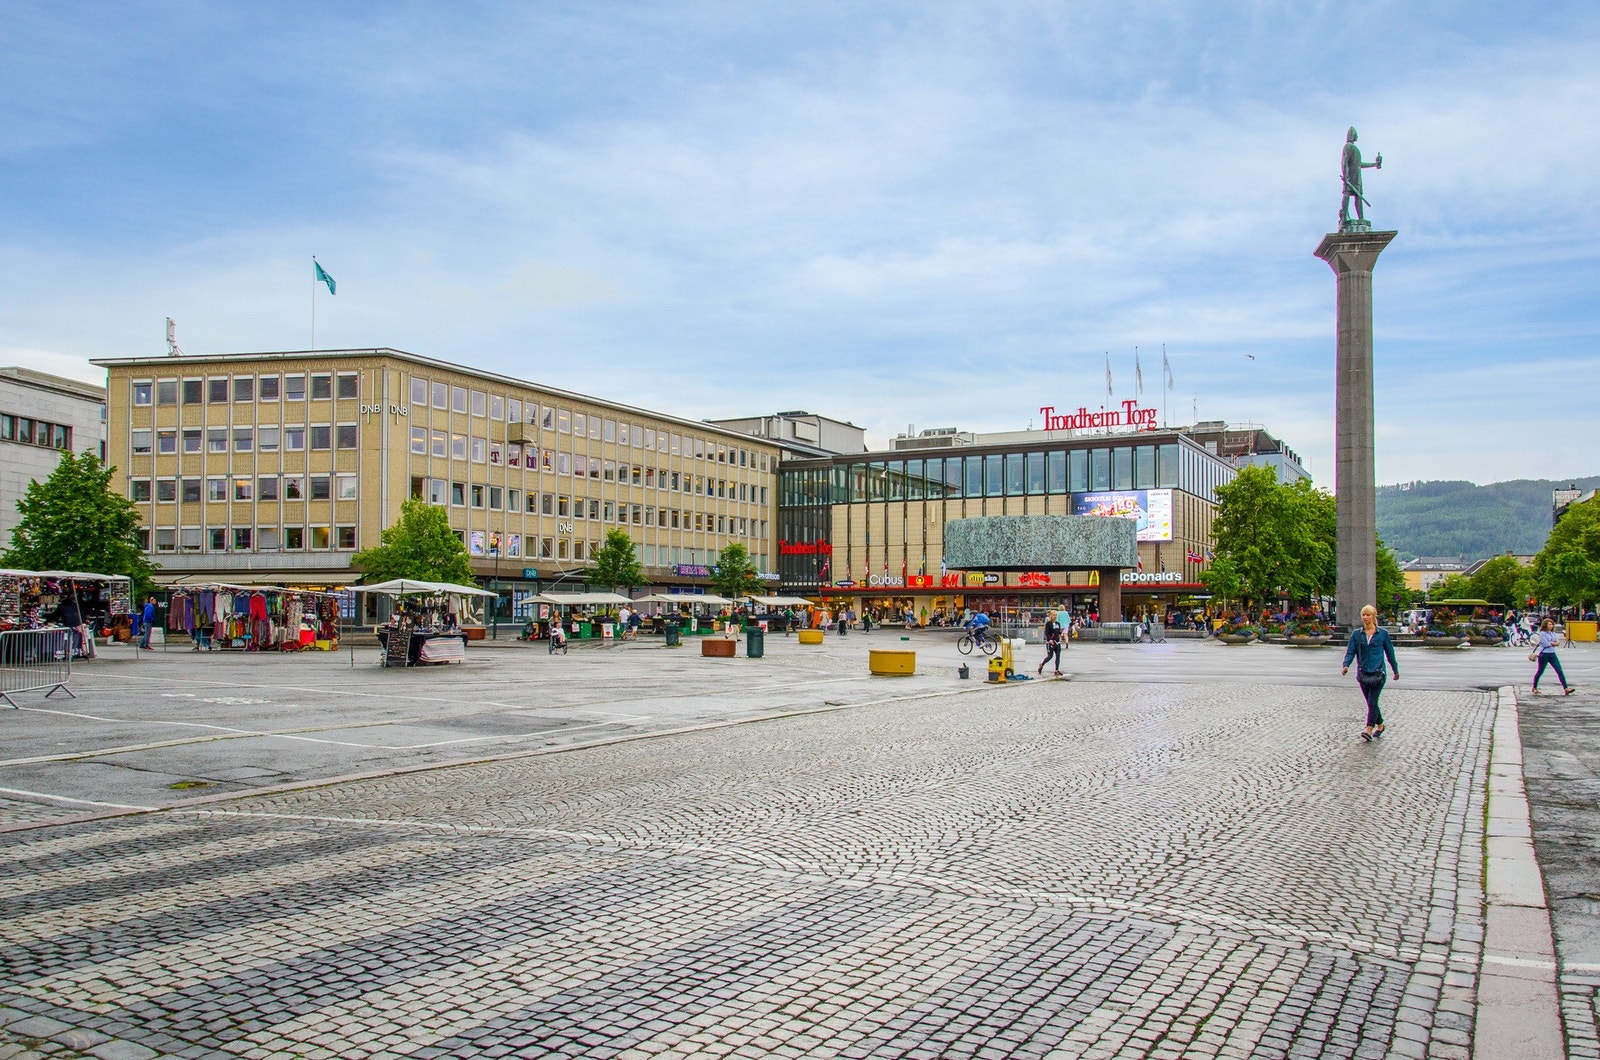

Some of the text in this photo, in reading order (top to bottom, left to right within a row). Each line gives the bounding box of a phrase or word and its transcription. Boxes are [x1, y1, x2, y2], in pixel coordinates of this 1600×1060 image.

[1040, 400, 1157, 431] Trondheim Torg
[559, 522, 573, 534] DNB
[779, 540, 816, 555] Trondheim
[526, 569, 537, 578] DNB
[869, 574, 903, 585] Cubus
